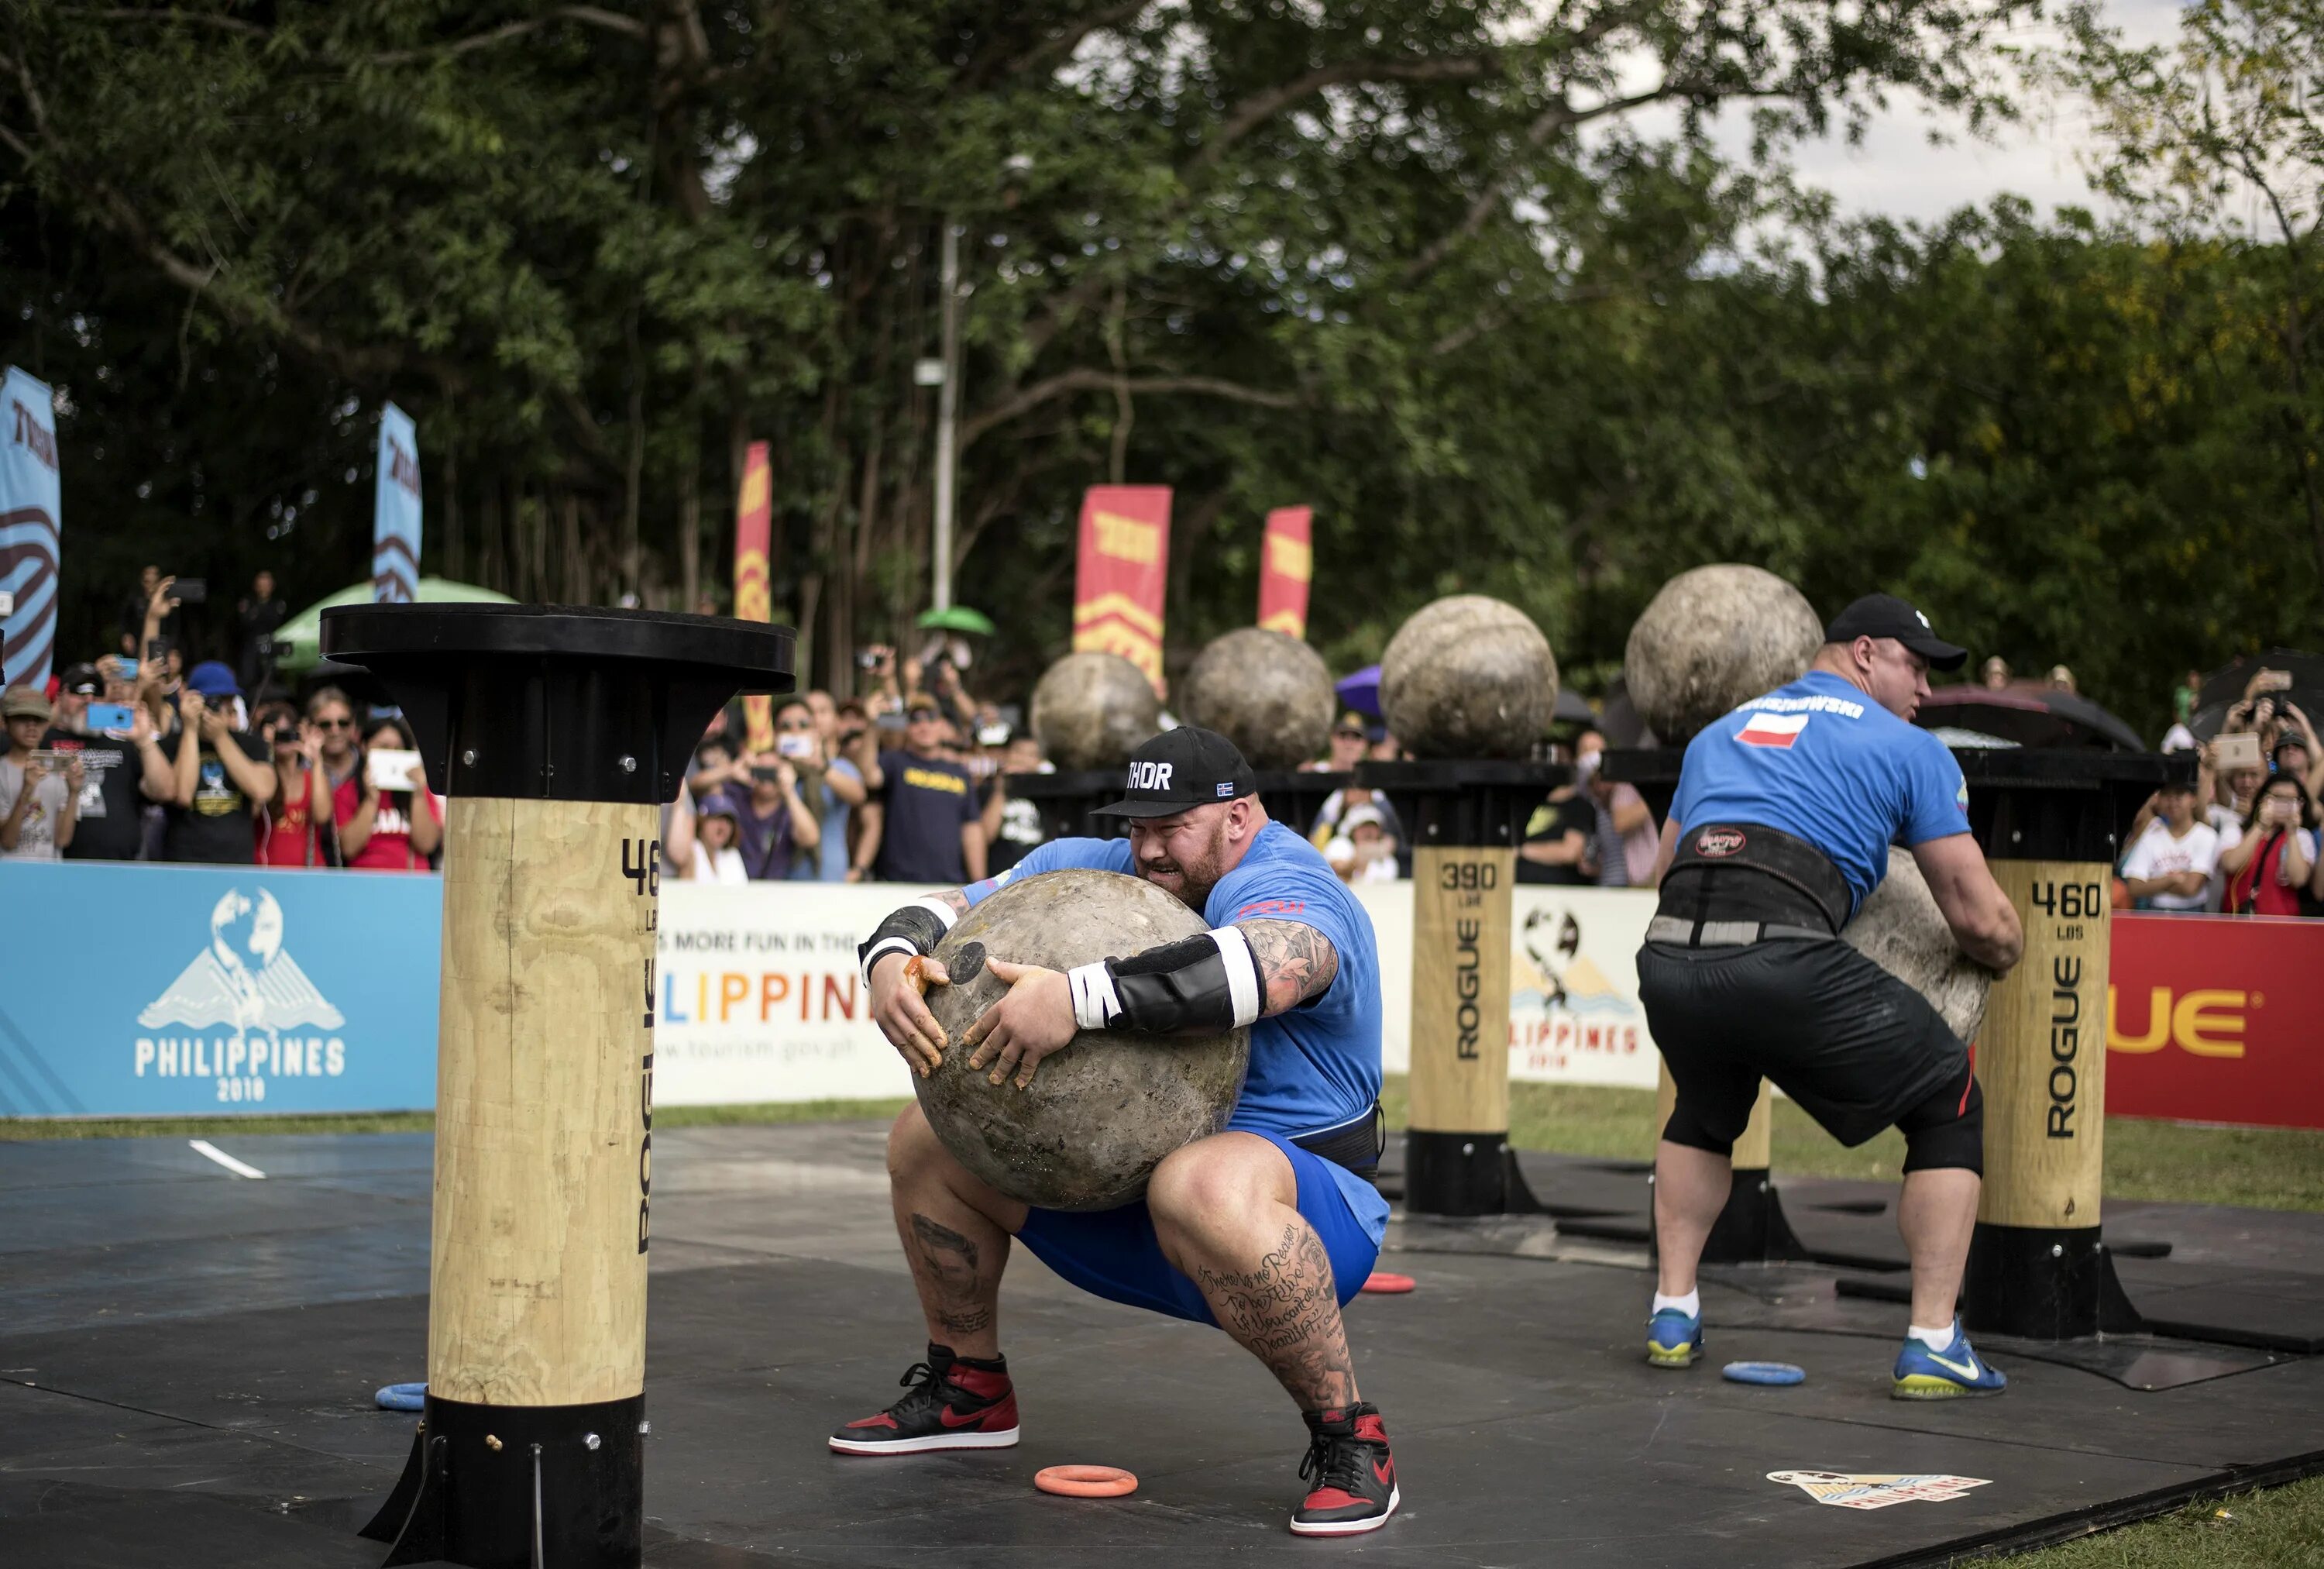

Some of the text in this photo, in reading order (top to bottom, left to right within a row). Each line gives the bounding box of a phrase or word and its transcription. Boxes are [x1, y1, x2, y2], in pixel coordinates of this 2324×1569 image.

[1127, 762, 1173, 790] THOR
[622, 838, 660, 896] 46
[1442, 862, 1496, 889] 390
[2032, 881, 2100, 917] 460
[676, 933, 734, 951] MORE
[747, 933, 786, 951] FUN
[796, 933, 814, 951] IN
[823, 934, 857, 952] THE
[664, 972, 875, 1022] LIPPIN
[1457, 918, 1480, 1060] ROGUE
[135, 1037, 346, 1078] PHILIPPINES
[2047, 955, 2082, 1140] ROGUE
[1841, 1478, 1981, 1508] PHILIPPINES
